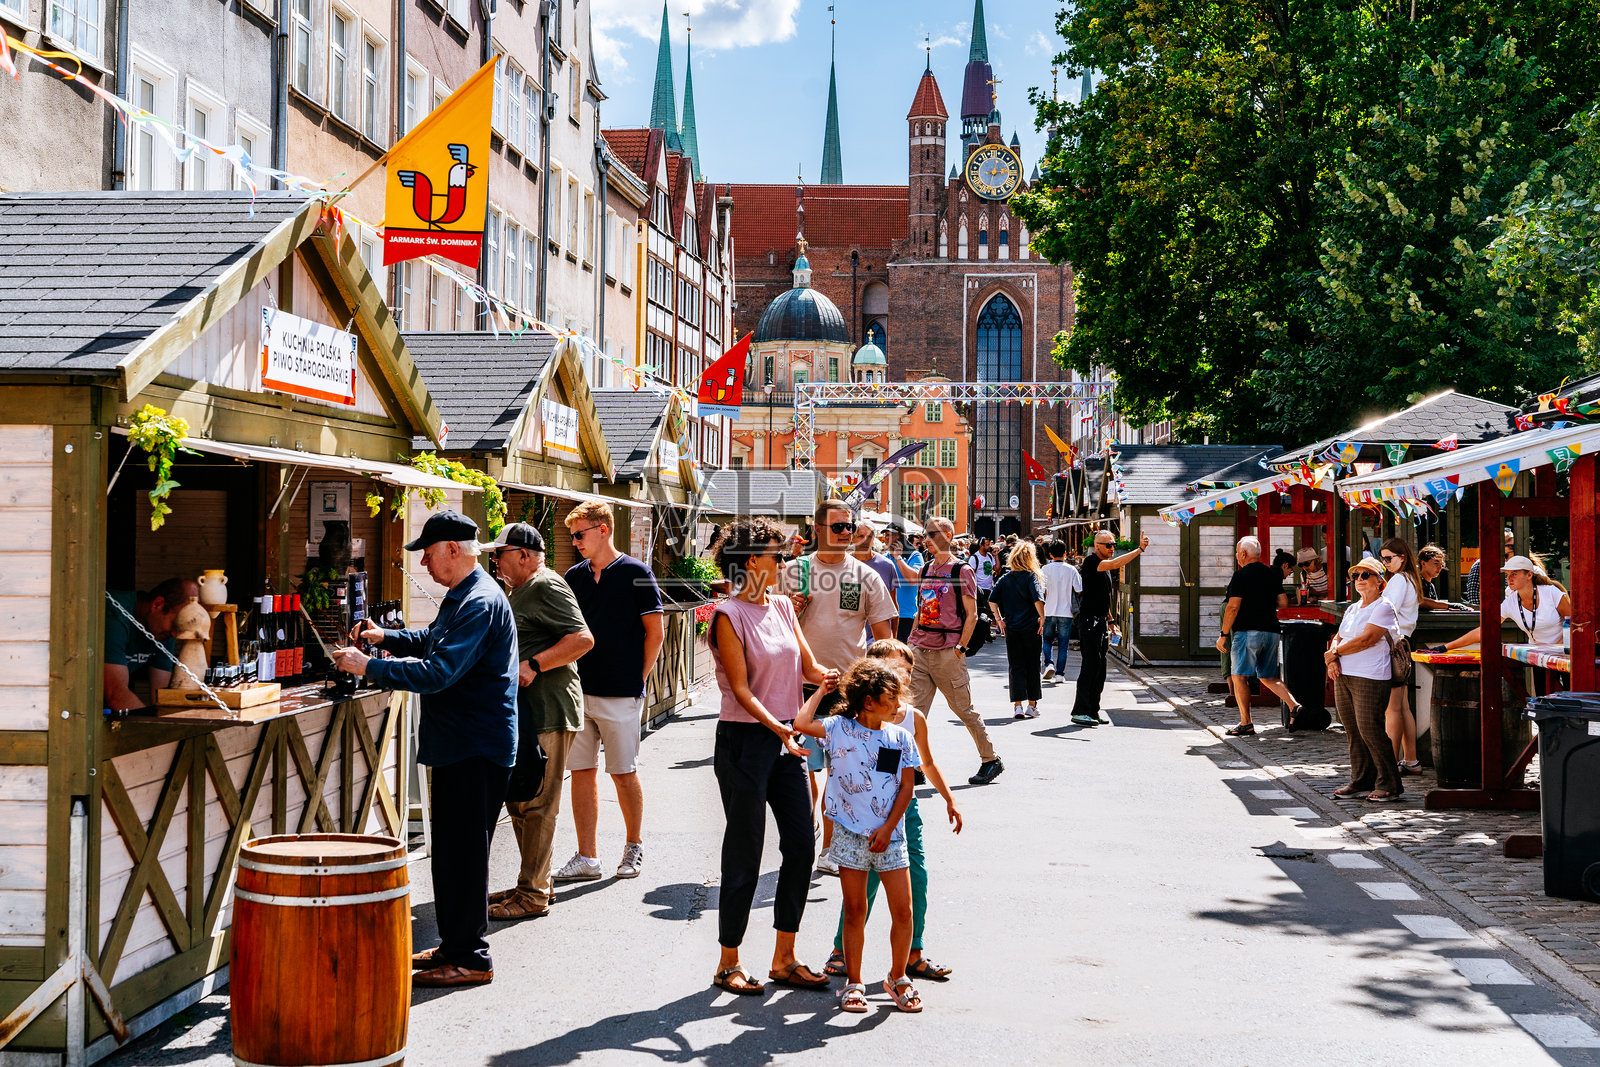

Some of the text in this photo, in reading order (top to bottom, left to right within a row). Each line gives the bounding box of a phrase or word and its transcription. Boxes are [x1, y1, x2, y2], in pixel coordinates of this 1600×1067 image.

[389, 236, 425, 244] JARMARK
[426, 237, 440, 245] ŚW.
[282, 331, 342, 362] KUCHNIA POLSKA
[273, 351, 349, 384] PIWO STAROGDAŃSKIE
